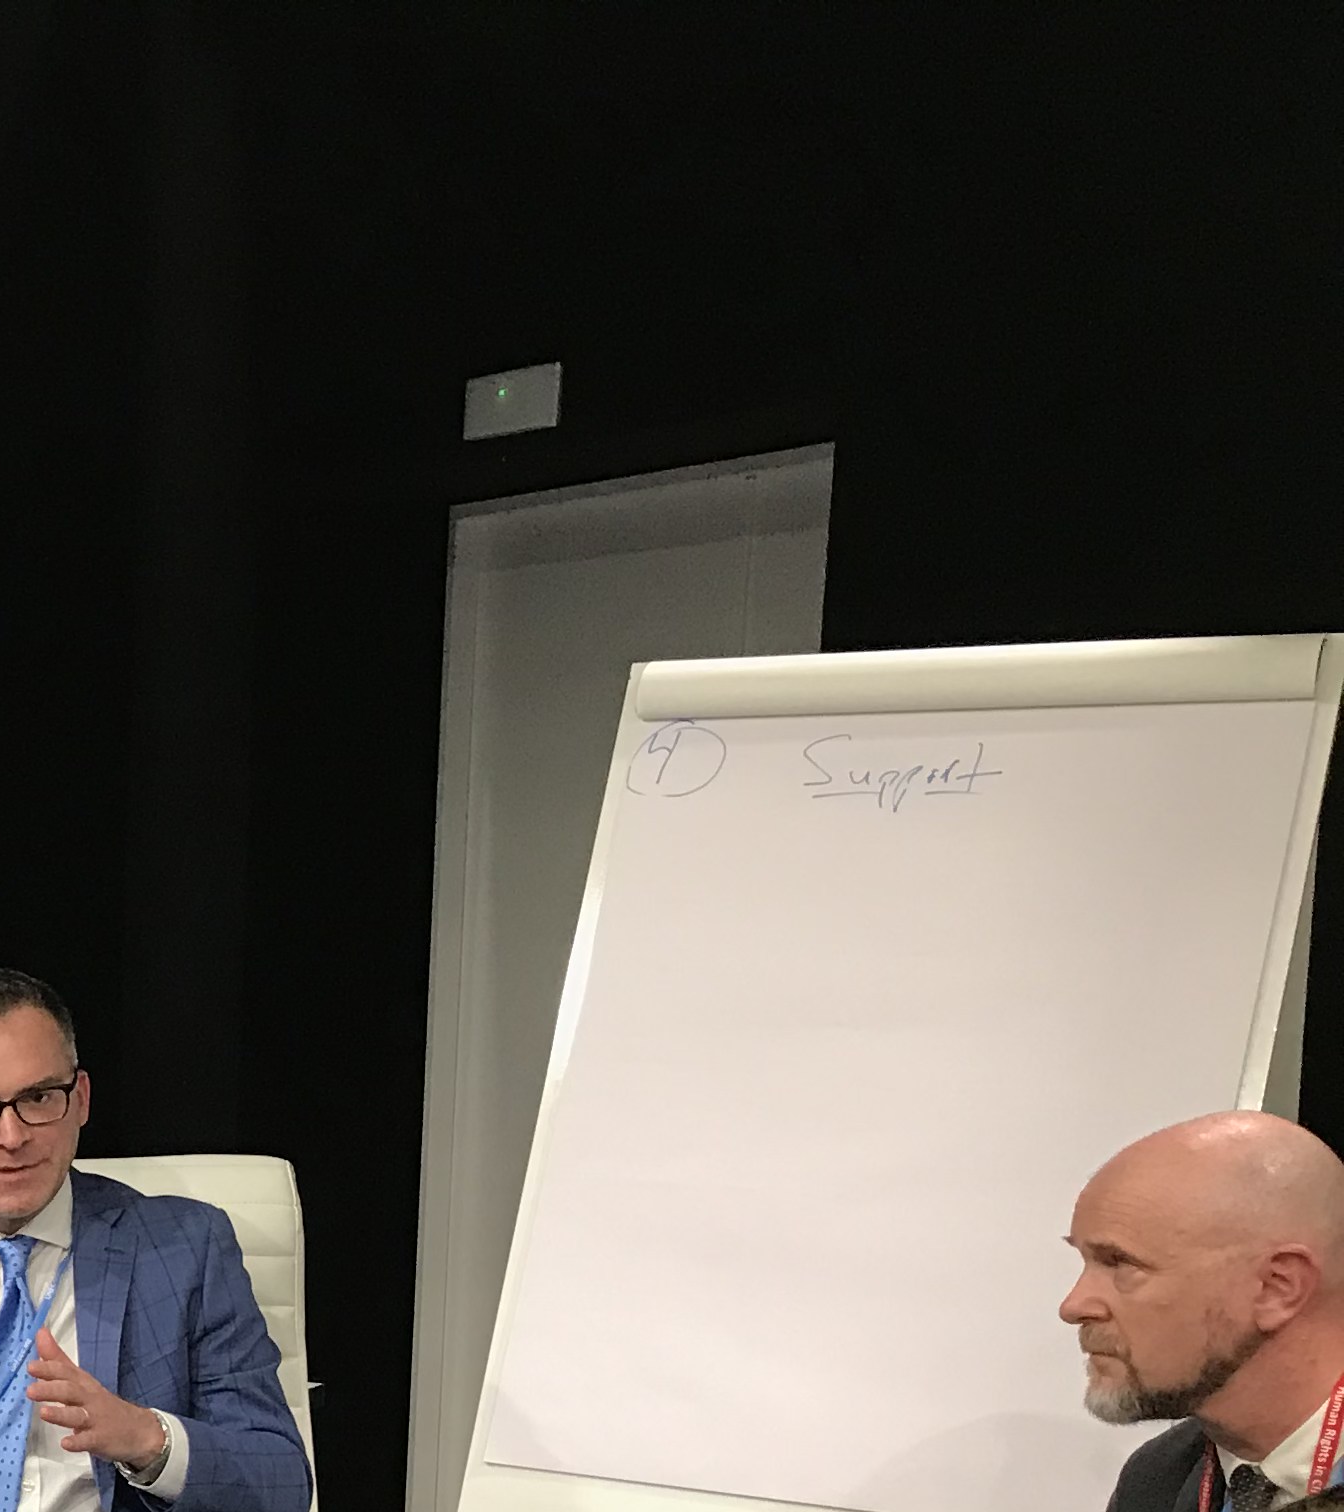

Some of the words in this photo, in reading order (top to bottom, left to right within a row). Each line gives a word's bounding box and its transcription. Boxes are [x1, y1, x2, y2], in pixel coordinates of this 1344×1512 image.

[803, 733, 1003, 813] Support
[1316, 1428, 1337, 1464] Rights
[1314, 1465, 1328, 1477] in
